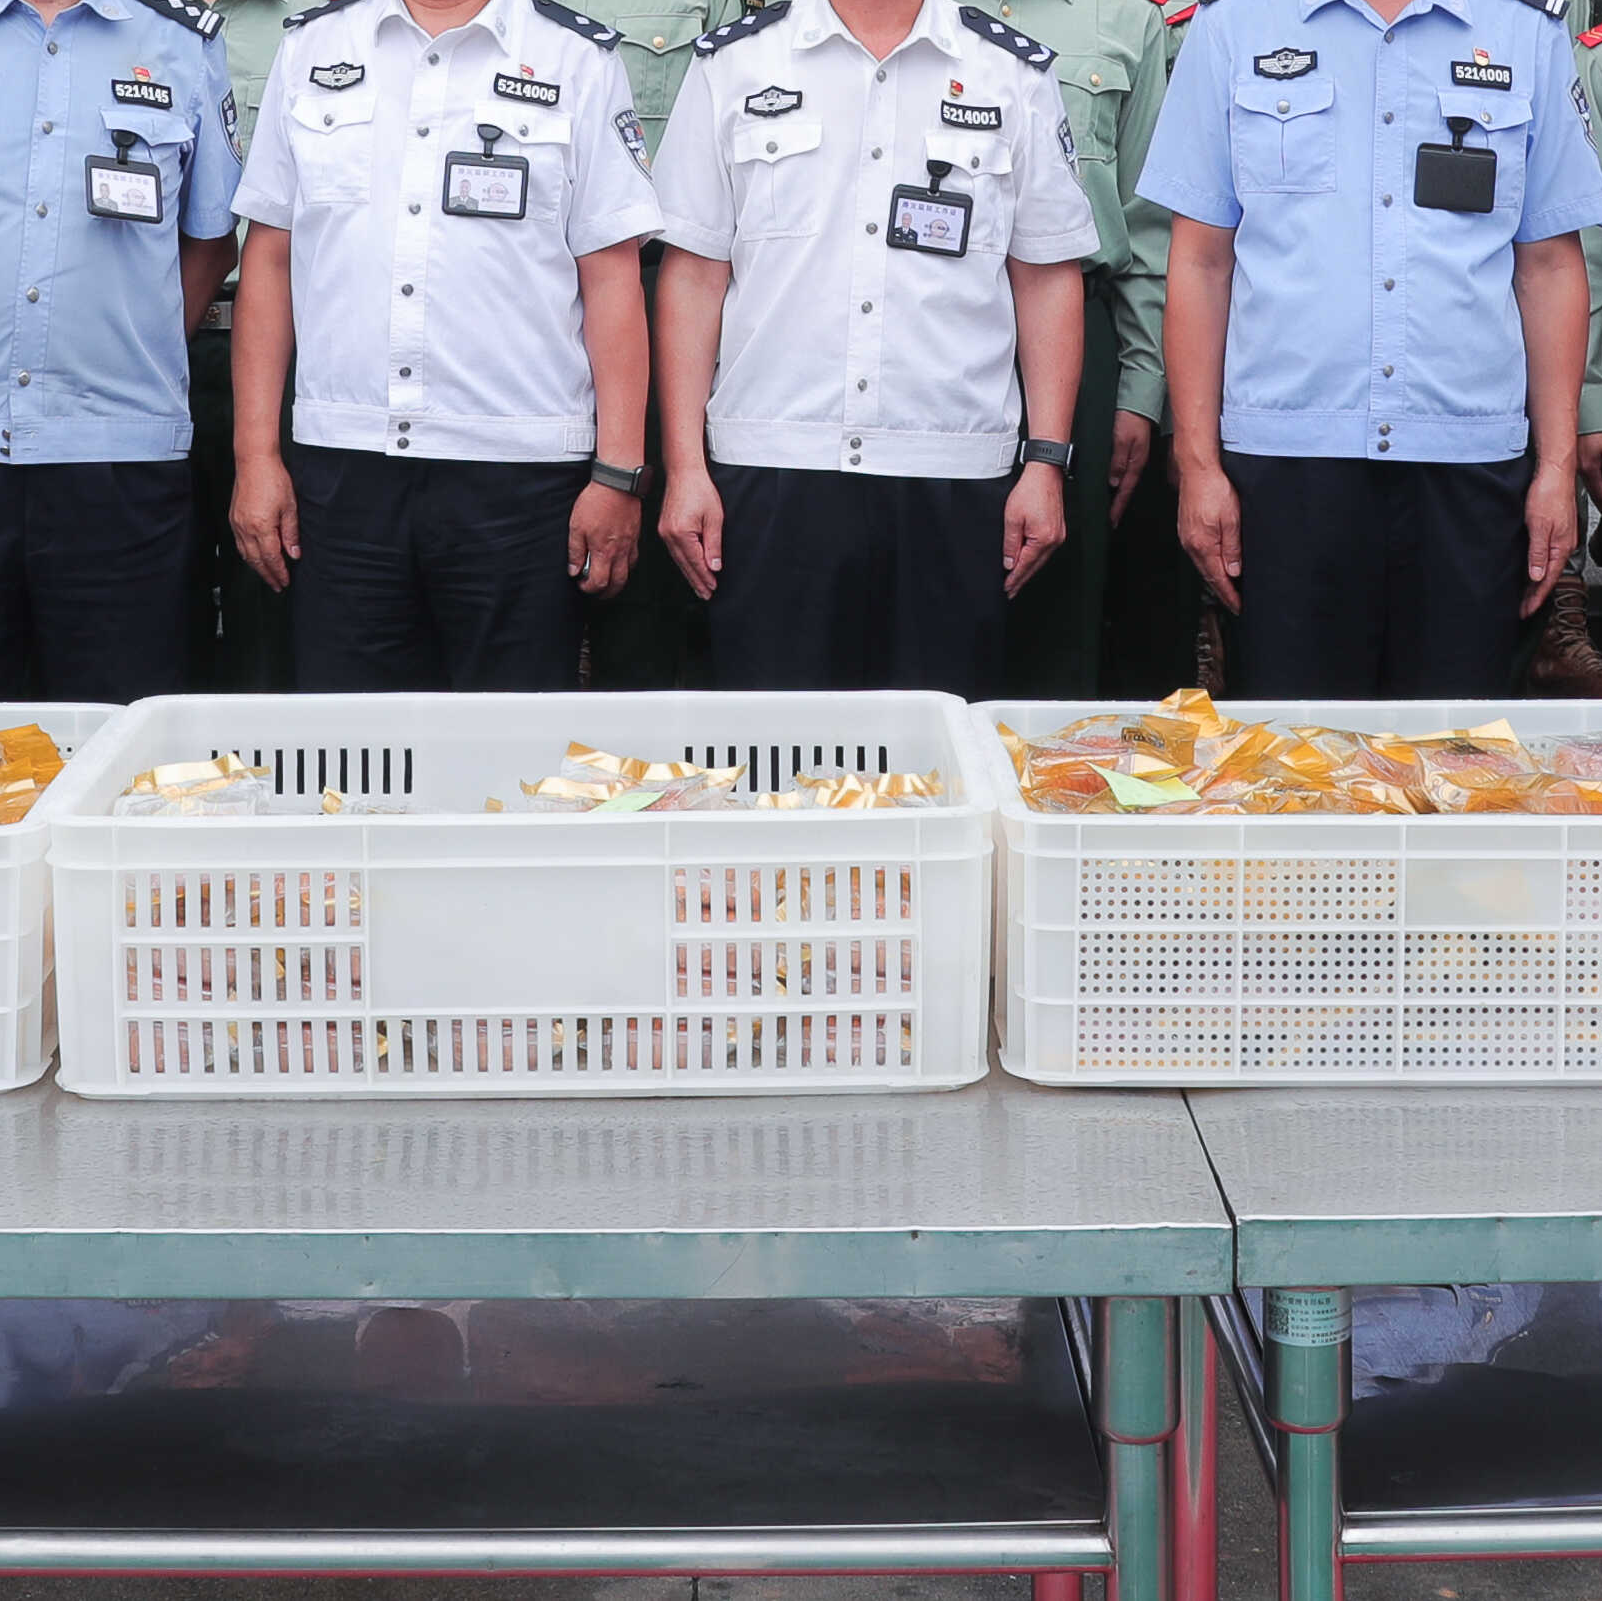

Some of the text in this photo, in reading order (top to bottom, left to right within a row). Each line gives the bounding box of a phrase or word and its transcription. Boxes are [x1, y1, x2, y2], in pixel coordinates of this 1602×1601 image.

[115, 83, 169, 104] 5214145
[497, 78, 557, 103] 5214006
[943, 106, 998, 126] 5214001
